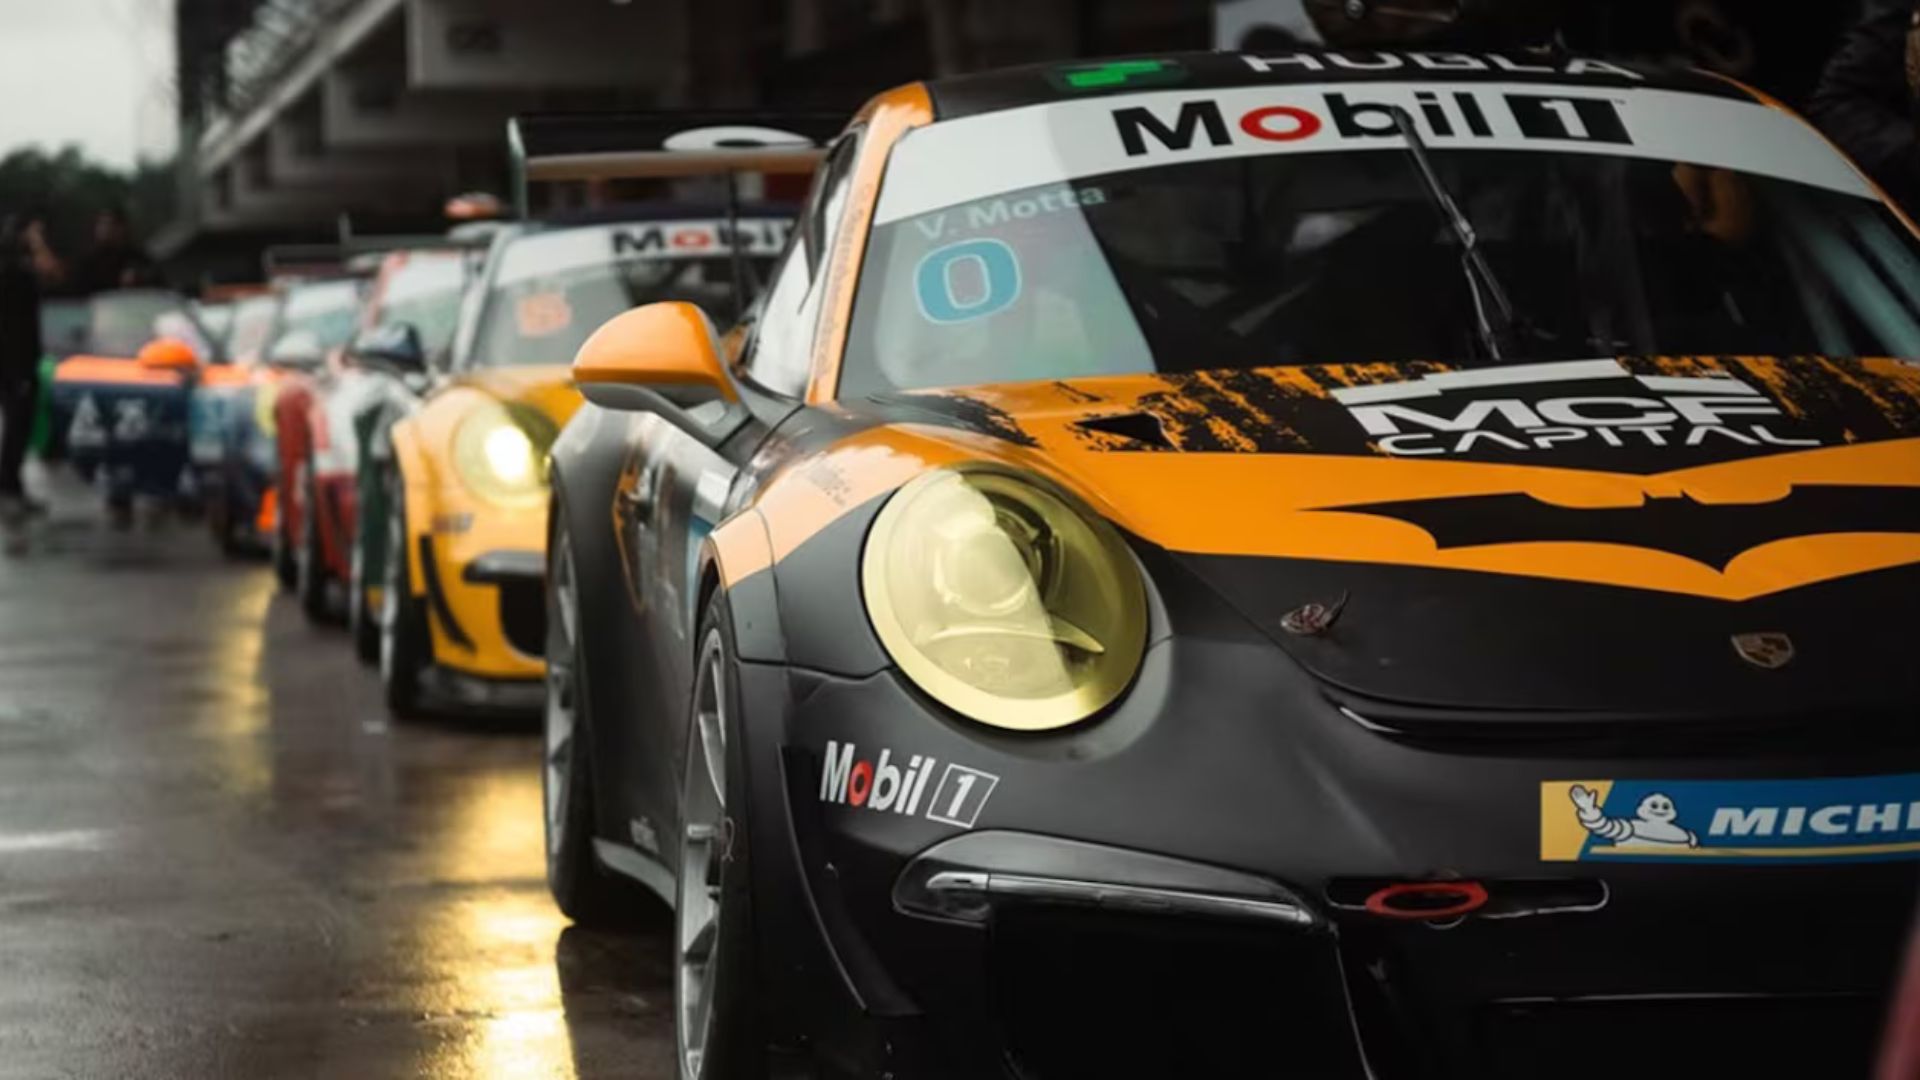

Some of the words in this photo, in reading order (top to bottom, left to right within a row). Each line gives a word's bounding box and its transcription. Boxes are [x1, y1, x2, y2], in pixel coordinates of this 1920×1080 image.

[1111, 92, 1495, 157] Mobil
[914, 213, 957, 241] V.
[966, 186, 1107, 229] Motta
[1346, 395, 1783, 436] MCF
[1378, 425, 1822, 456] CAPITAL
[819, 740, 936, 815] Mobil
